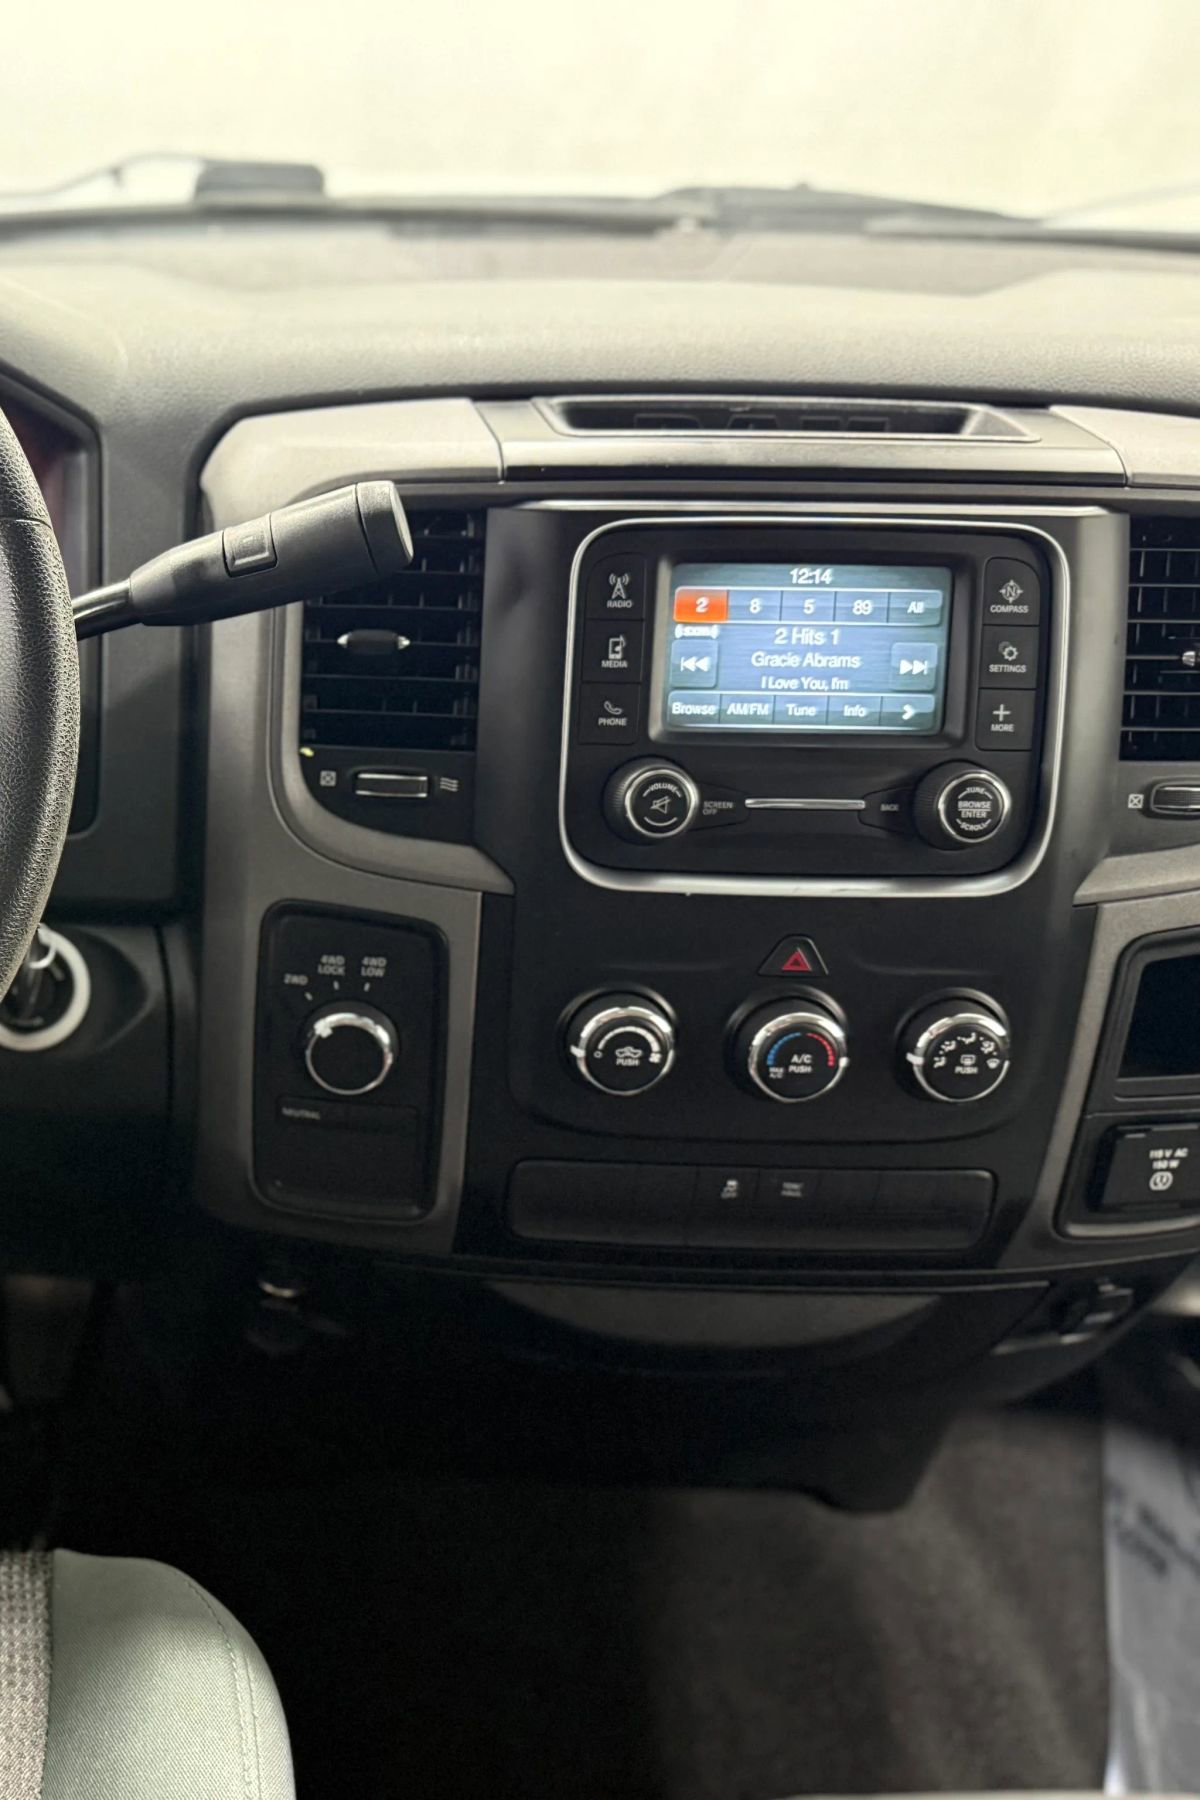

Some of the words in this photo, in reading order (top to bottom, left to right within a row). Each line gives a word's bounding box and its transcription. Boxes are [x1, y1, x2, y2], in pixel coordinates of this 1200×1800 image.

[790, 568, 833, 584] 12:14
[607, 600, 632, 608] RADIO
[695, 597, 710, 613] 2
[749, 598, 761, 614] 8
[803, 599, 816, 614] 5
[852, 599, 873, 615] 89
[990, 605, 1029, 613] COMPASS
[774, 627, 788, 645] 2
[791, 626, 826, 645] Hits
[830, 628, 840, 645] 1
[601, 660, 628, 668] MEDIA
[751, 651, 800, 667] Gracie
[802, 652, 861, 669] Abrams
[989, 664, 1026, 673] SETTINGS
[761, 676, 768, 689] I
[769, 676, 799, 689] Love
[800, 677, 829, 691] You,
[671, 702, 717, 715] Browse
[726, 703, 769, 716] AM/FM
[785, 703, 817, 716] Tune
[843, 704, 867, 717] Info
[598, 718, 627, 726] PHONE
[991, 723, 1014, 732] MORE
[649, 782, 678, 792] VOLUME
[703, 801, 733, 809] SCREEN
[881, 804, 899, 812] BACK
[957, 801, 991, 809] BROWSE
[960, 810, 987, 819] ENTER
[318, 965, 345, 976] LOCK
[361, 966, 385, 978] LOW
[615, 1059, 640, 1067] PUSH
[790, 1054, 812, 1064] A/C
[788, 1065, 812, 1073] PUSH
[954, 1066, 979, 1074] PUSH
